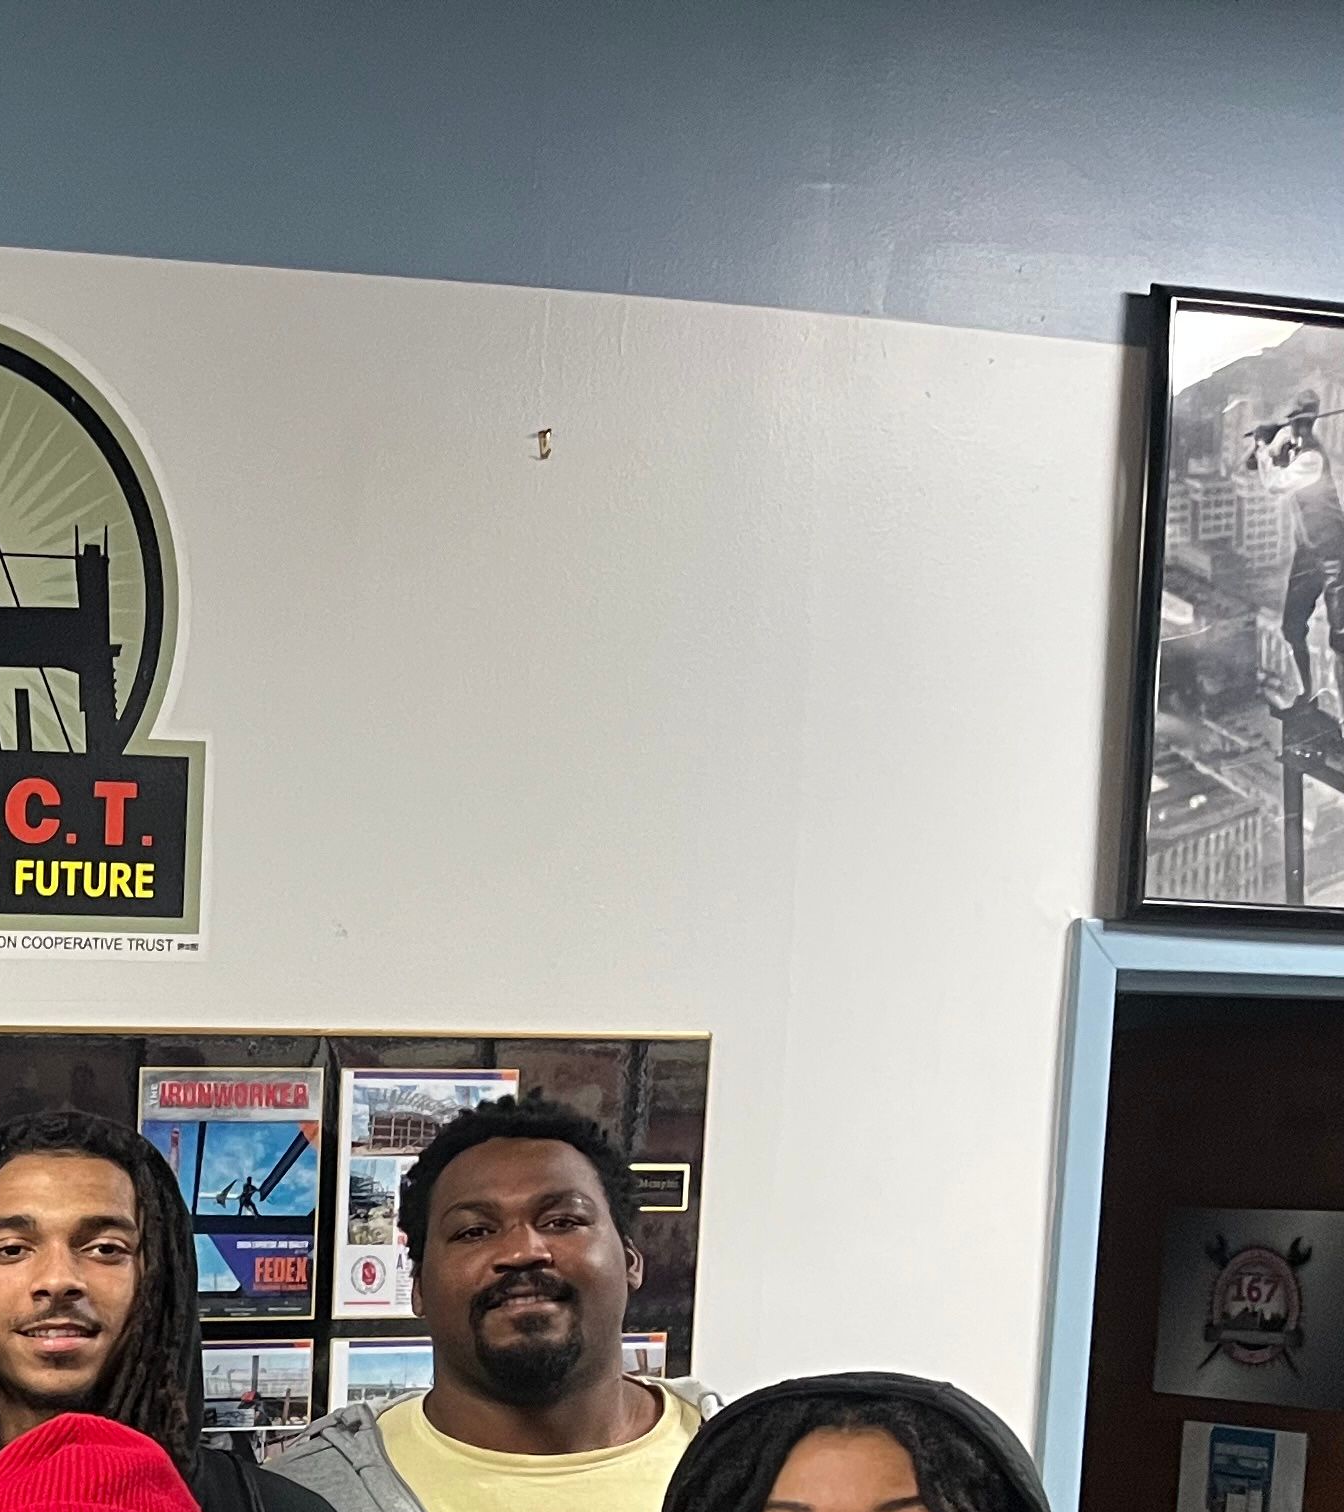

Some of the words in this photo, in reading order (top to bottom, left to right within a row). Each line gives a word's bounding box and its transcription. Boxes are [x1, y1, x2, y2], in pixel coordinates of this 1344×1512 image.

[15, 859, 155, 898] FUTURE
[21, 935, 123, 951] COOPERATIVE
[127, 938, 174, 952] TRUST
[160, 1080, 310, 1109] IRONWORKER
[255, 1256, 308, 1283] FEDEX
[1230, 1275, 1280, 1304] 167
